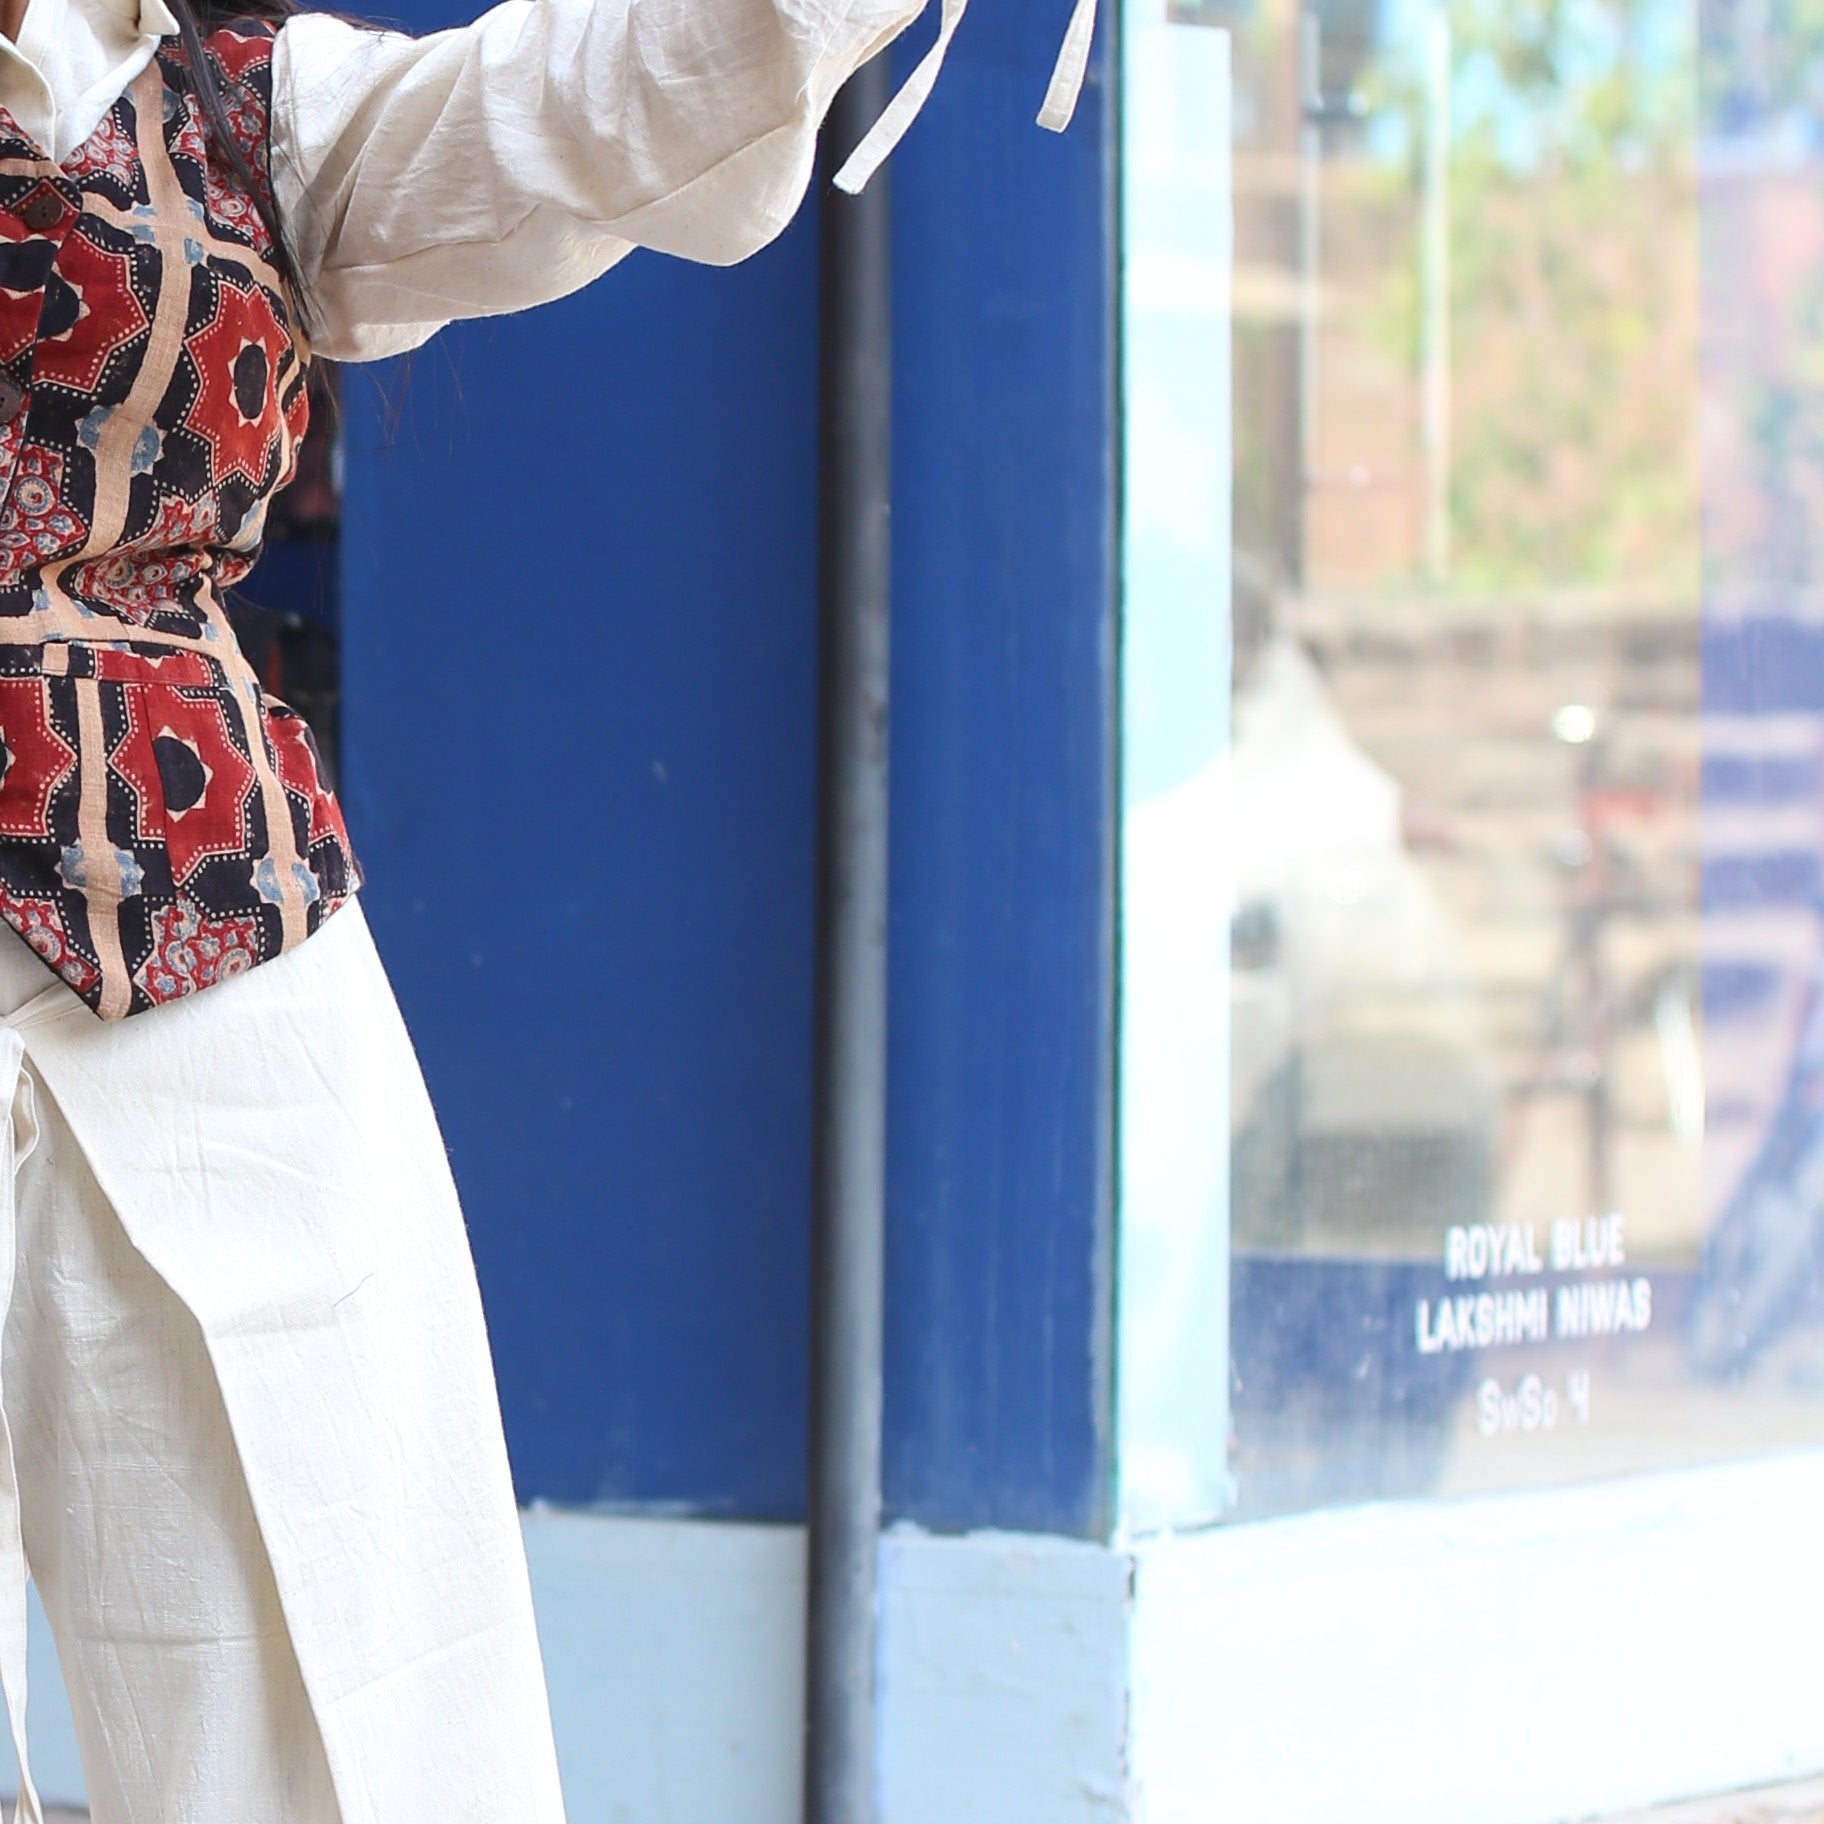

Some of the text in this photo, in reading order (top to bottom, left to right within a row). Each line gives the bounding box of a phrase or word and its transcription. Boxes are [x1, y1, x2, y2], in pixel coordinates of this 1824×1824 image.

[1446, 1211, 1625, 1281] ROYAL BLUE
[1414, 1277, 1651, 1354] LAKSHMI NIWAS
